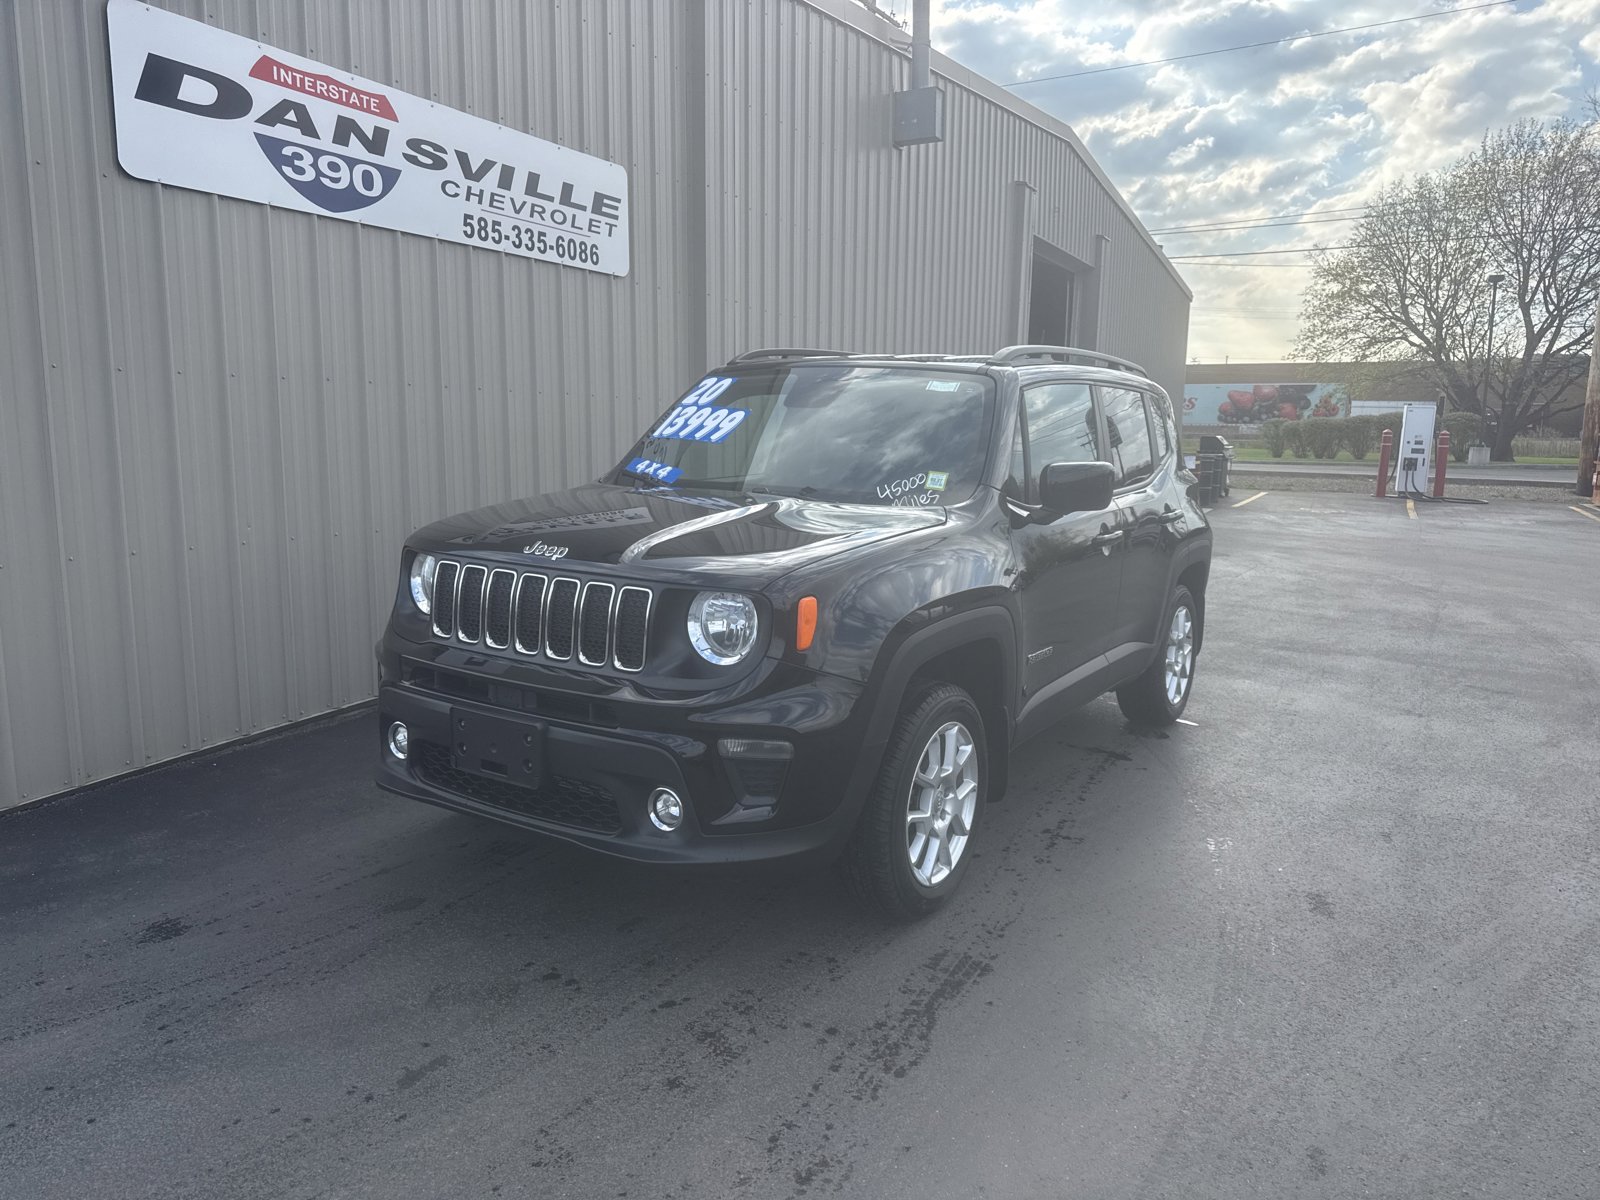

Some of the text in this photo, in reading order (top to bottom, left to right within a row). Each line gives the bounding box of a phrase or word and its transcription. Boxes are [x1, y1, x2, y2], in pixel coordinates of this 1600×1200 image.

[272, 65, 380, 113] INTERSTATE
[134, 52, 622, 220] DANSVILLE
[281, 145, 383, 198] 390
[440, 179, 618, 238] CHEVROLET
[462, 213, 600, 266] 585-335-6086
[681, 377, 733, 405] 20
[652, 405, 745, 442] 13999
[876, 473, 927, 499] 45000
[523, 540, 569, 561] Jeep
